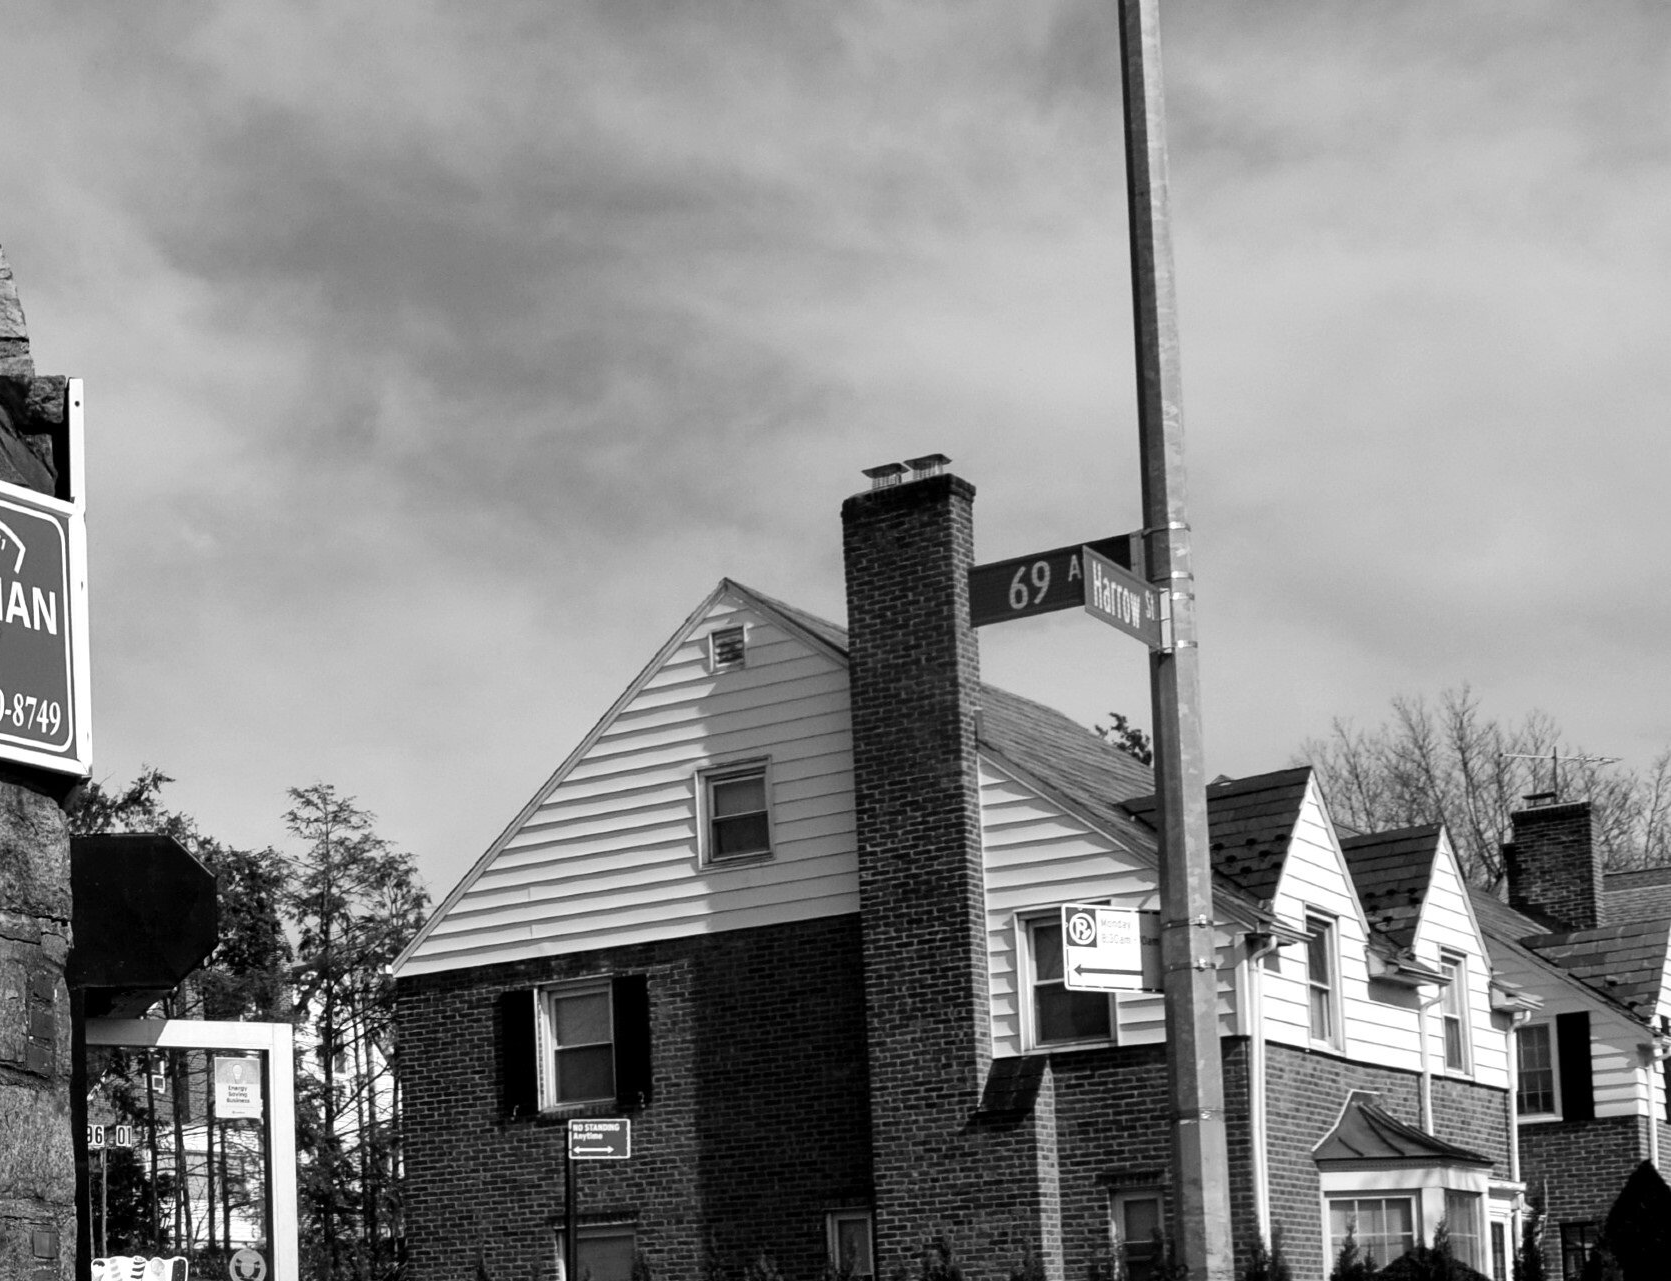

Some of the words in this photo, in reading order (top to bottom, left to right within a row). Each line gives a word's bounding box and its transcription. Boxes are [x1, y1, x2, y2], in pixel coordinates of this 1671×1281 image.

[1009, 561, 1050, 610] 69
[1068, 554, 1082, 582] A
[1092, 560, 1141, 629] Harrow
[1145, 589, 1155, 620] St
[573, 1132, 604, 1141] Anytime
[584, 1123, 620, 1132] STANDING
